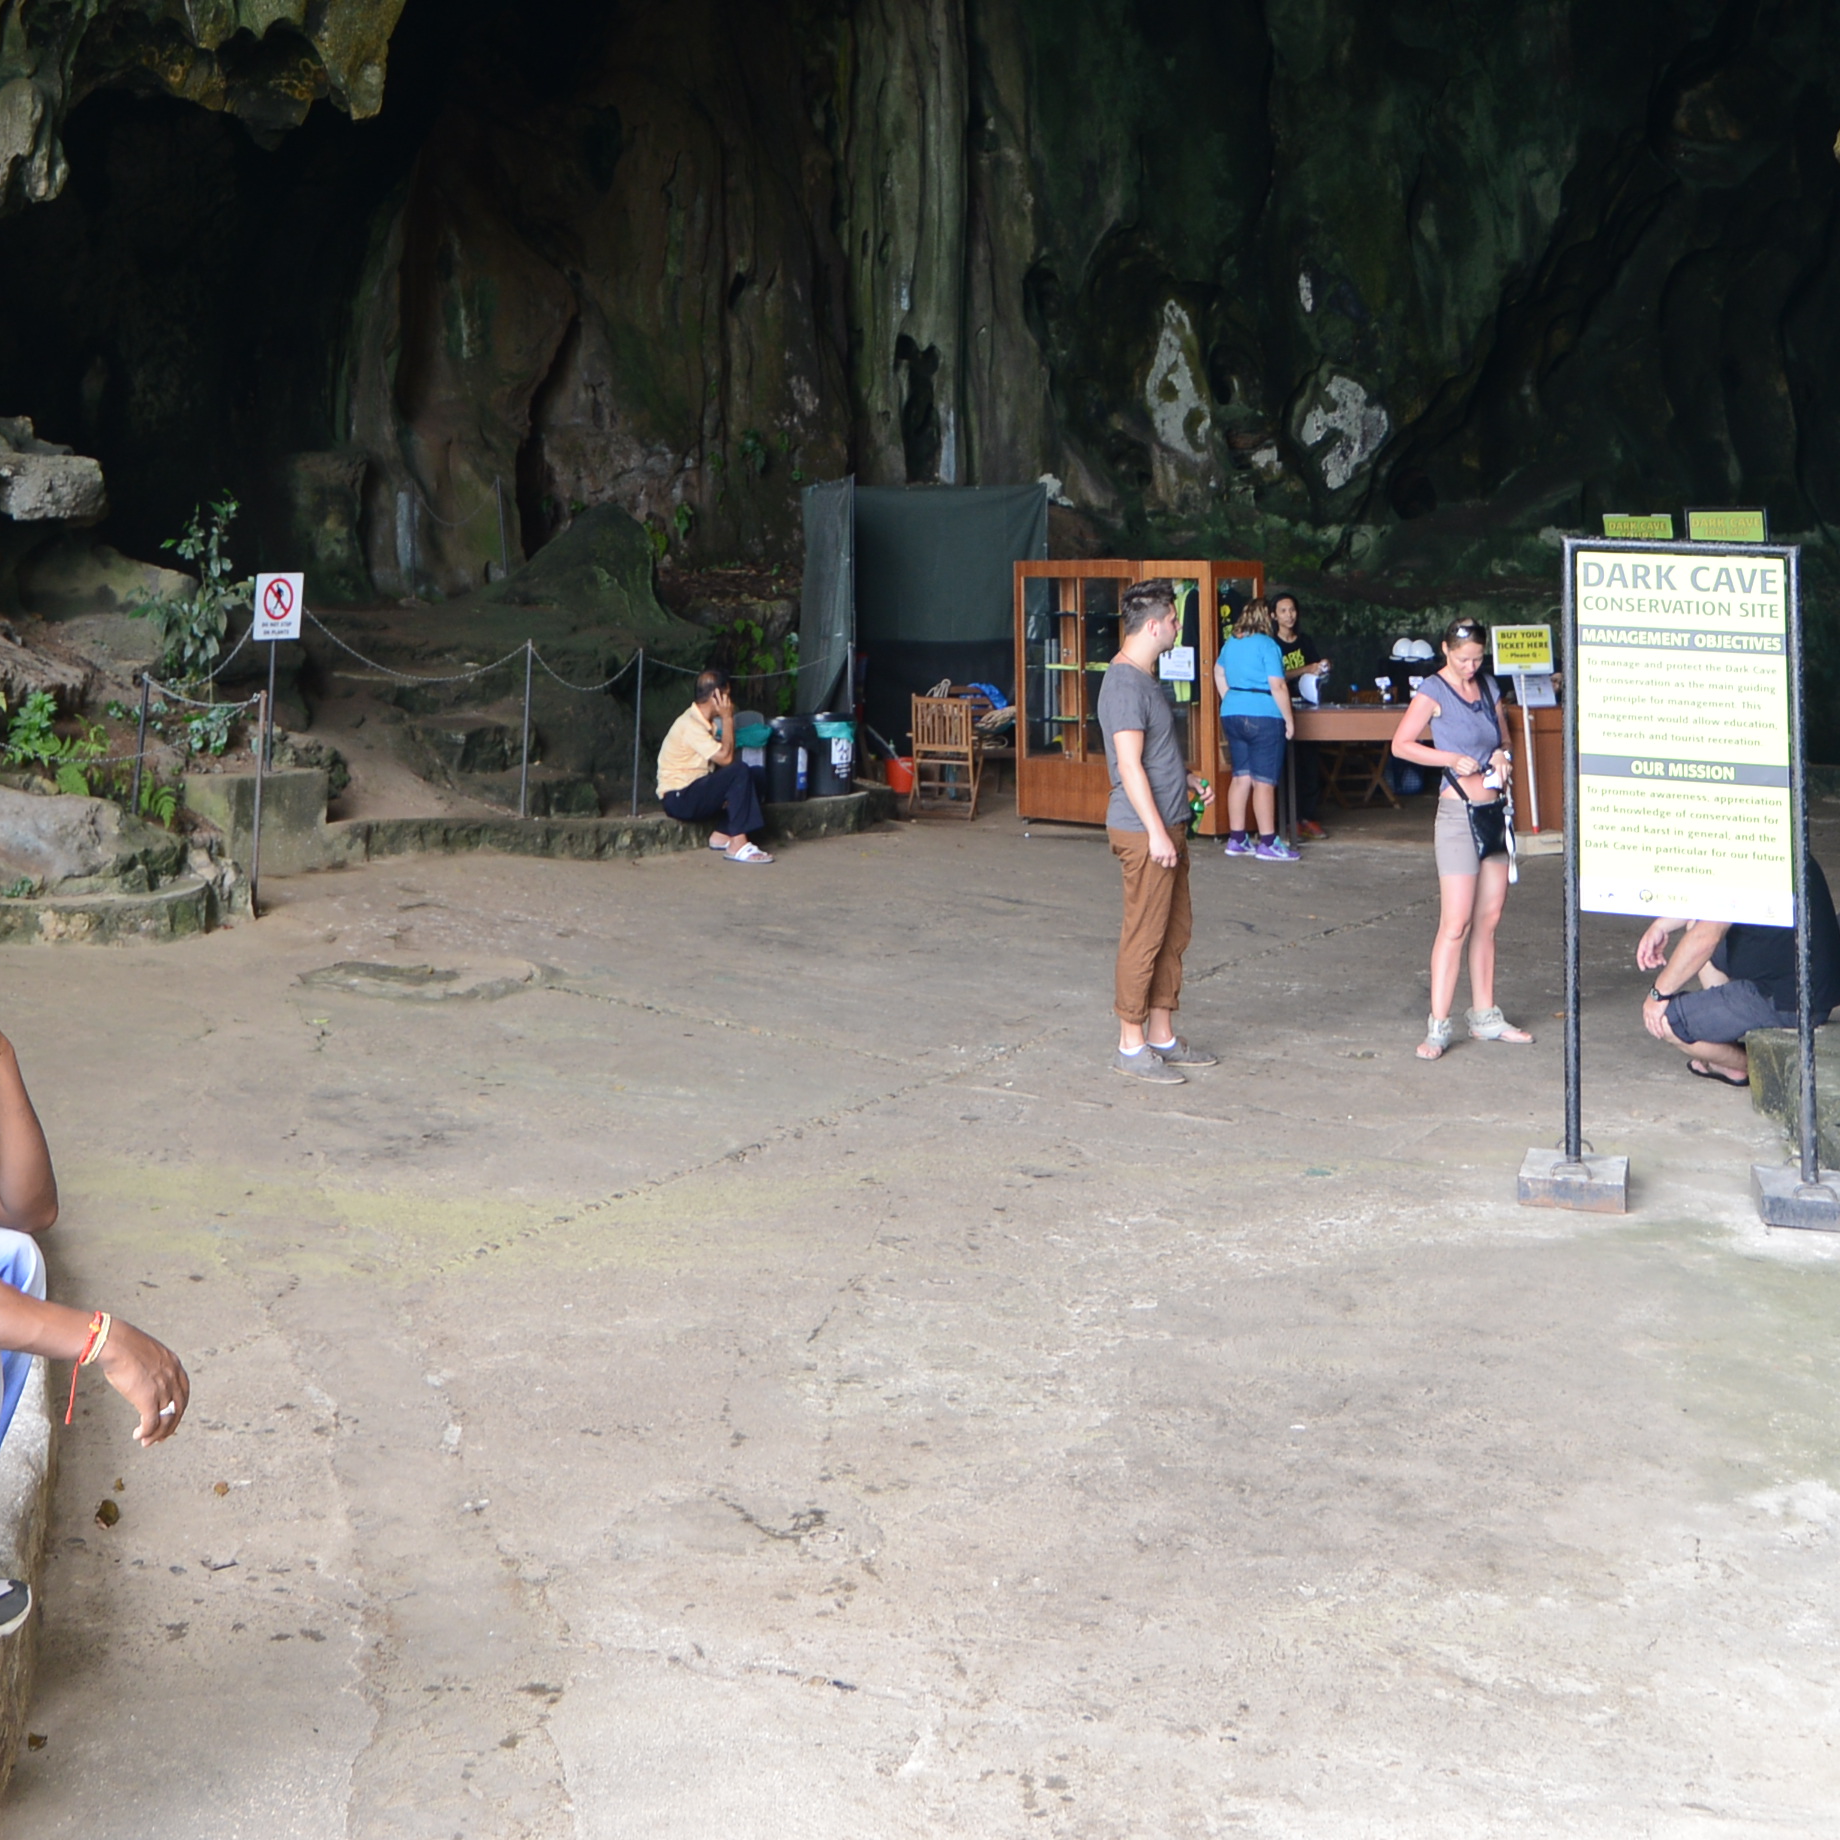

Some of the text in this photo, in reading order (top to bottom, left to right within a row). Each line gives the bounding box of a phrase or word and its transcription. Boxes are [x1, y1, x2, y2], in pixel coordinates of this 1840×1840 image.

[1608, 521, 1667, 531] DARK CAVE
[1691, 517, 1762, 529] DARK CAVE
[1582, 561, 1779, 595] DARK CAVE
[1583, 595, 1779, 619] CONSERVATION SITE
[1500, 631, 1544, 639] BUY YOUR
[1581, 628, 1782, 652] MANAGEMENT OBJECTIVES
[1497, 642, 1525, 650] TICKET
[1587, 657, 1777, 674] To manage and protect the Dark Cave
[1588, 674, 1776, 695] for conservation as the main guiding
[1603, 692, 1647, 705] principle
[1650, 695, 1664, 704] for
[1742, 701, 1762, 710] This
[1587, 712, 1778, 731] management would allow education,
[1602, 730, 1645, 739] research
[1649, 732, 1668, 741] and
[1671, 734, 1705, 743] tourist
[1630, 759, 1736, 781] OUR MISSION
[1587, 785, 1783, 807] To promote awareness, appreciation
[1590, 804, 1779, 825] and knowledge of conservation for
[1593, 823, 1777, 843] cave and karst in general, and the
[1584, 839, 1786, 862] Dark Cave in particular for our future
